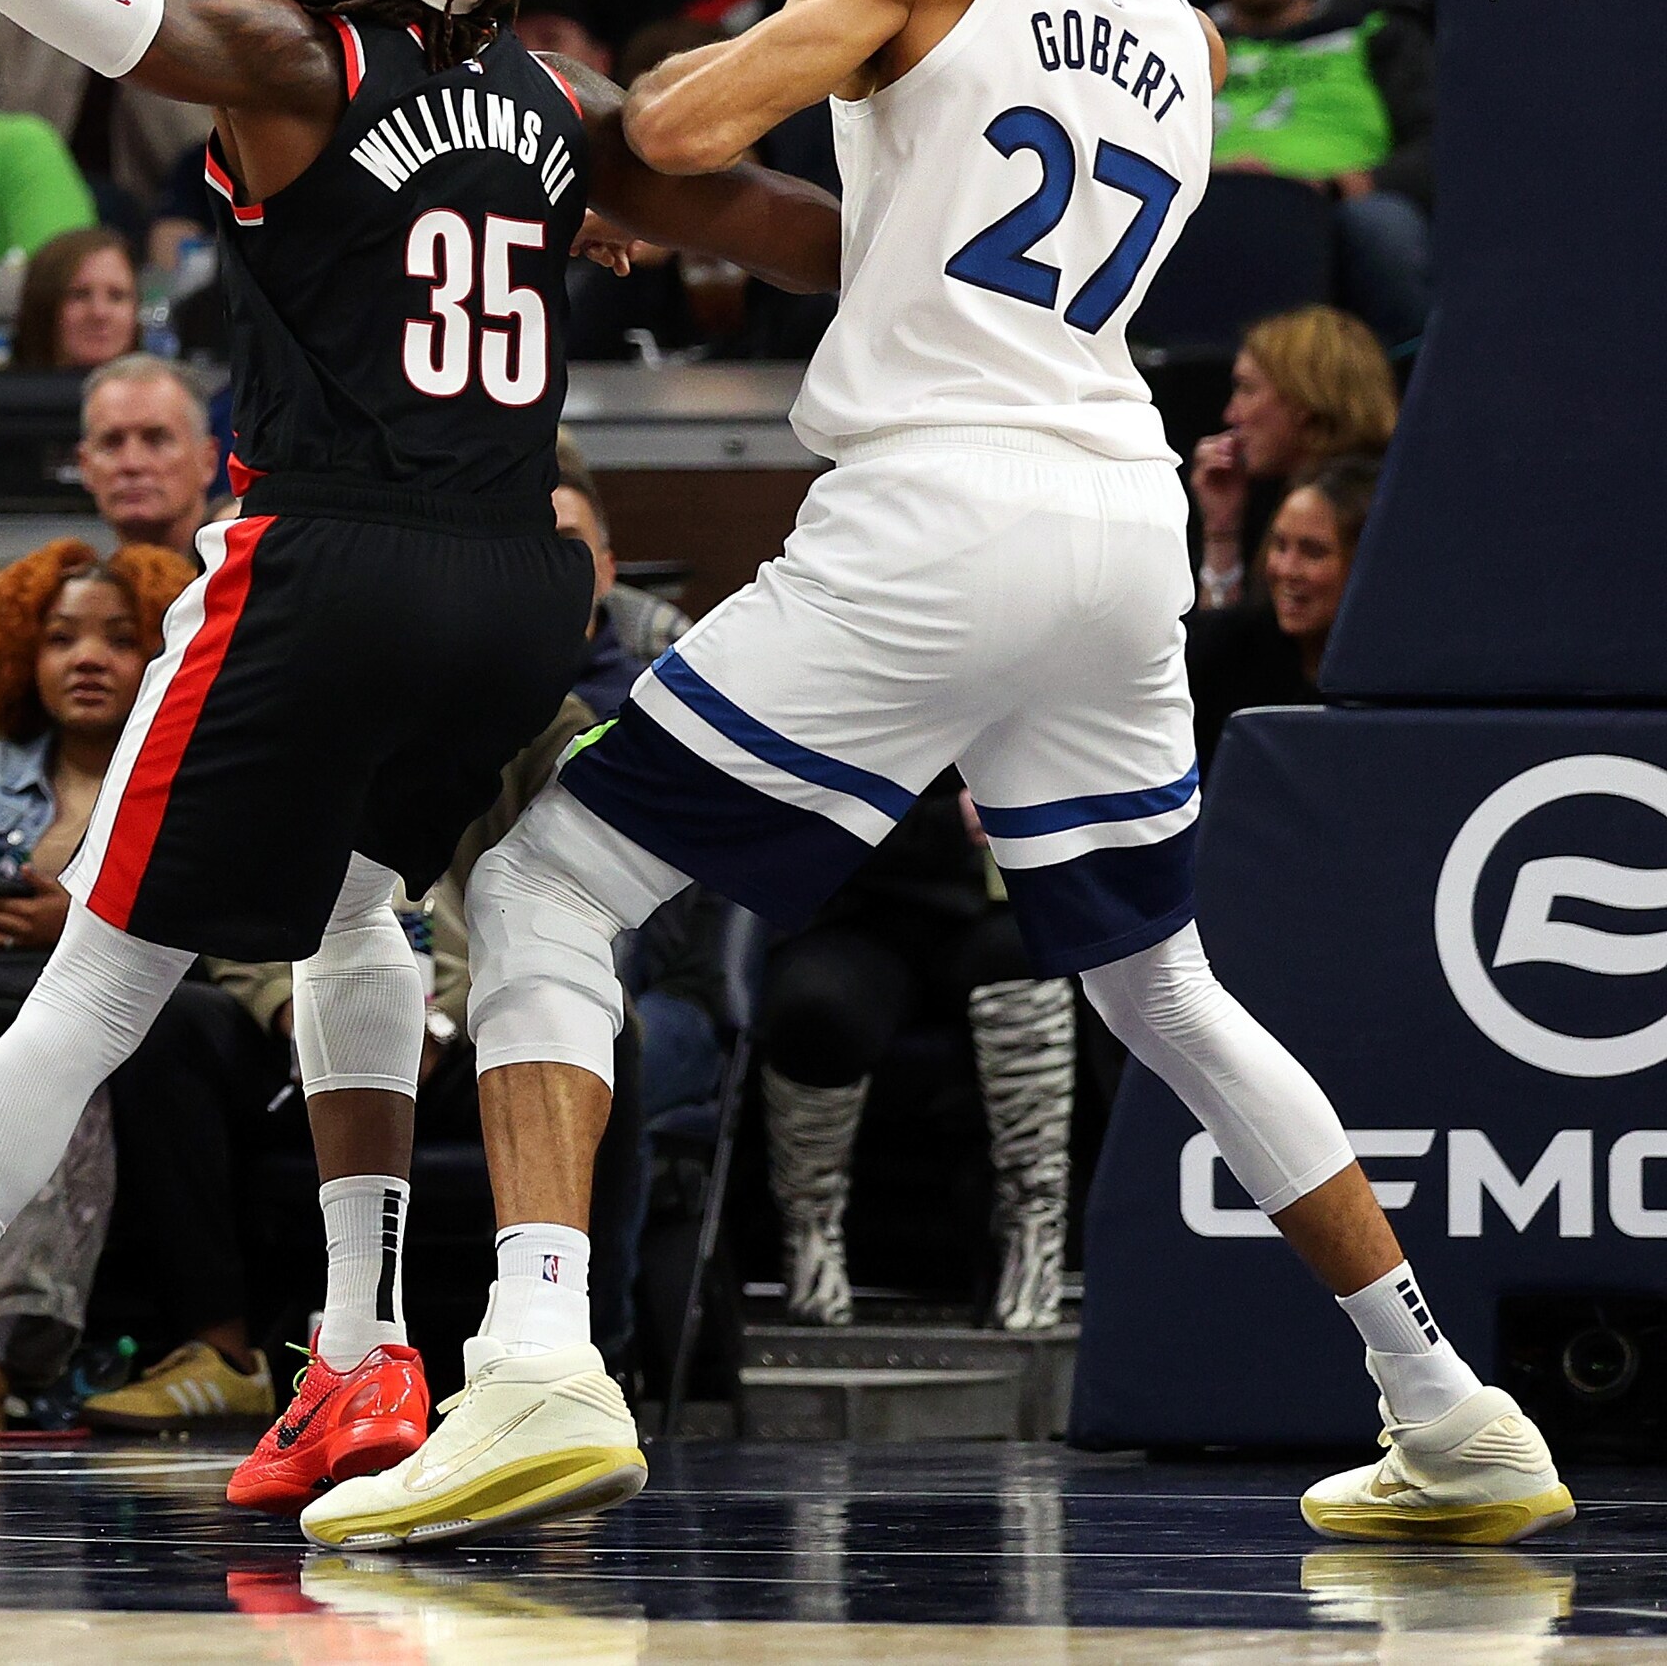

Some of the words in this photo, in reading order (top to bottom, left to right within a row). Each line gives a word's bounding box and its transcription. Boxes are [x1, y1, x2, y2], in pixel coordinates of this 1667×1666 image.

[349, 87, 542, 193] WILLIAMS
[1031, 9, 1185, 123] GOBERT
[945, 106, 1182, 335] 27
[401, 207, 551, 409] 35
